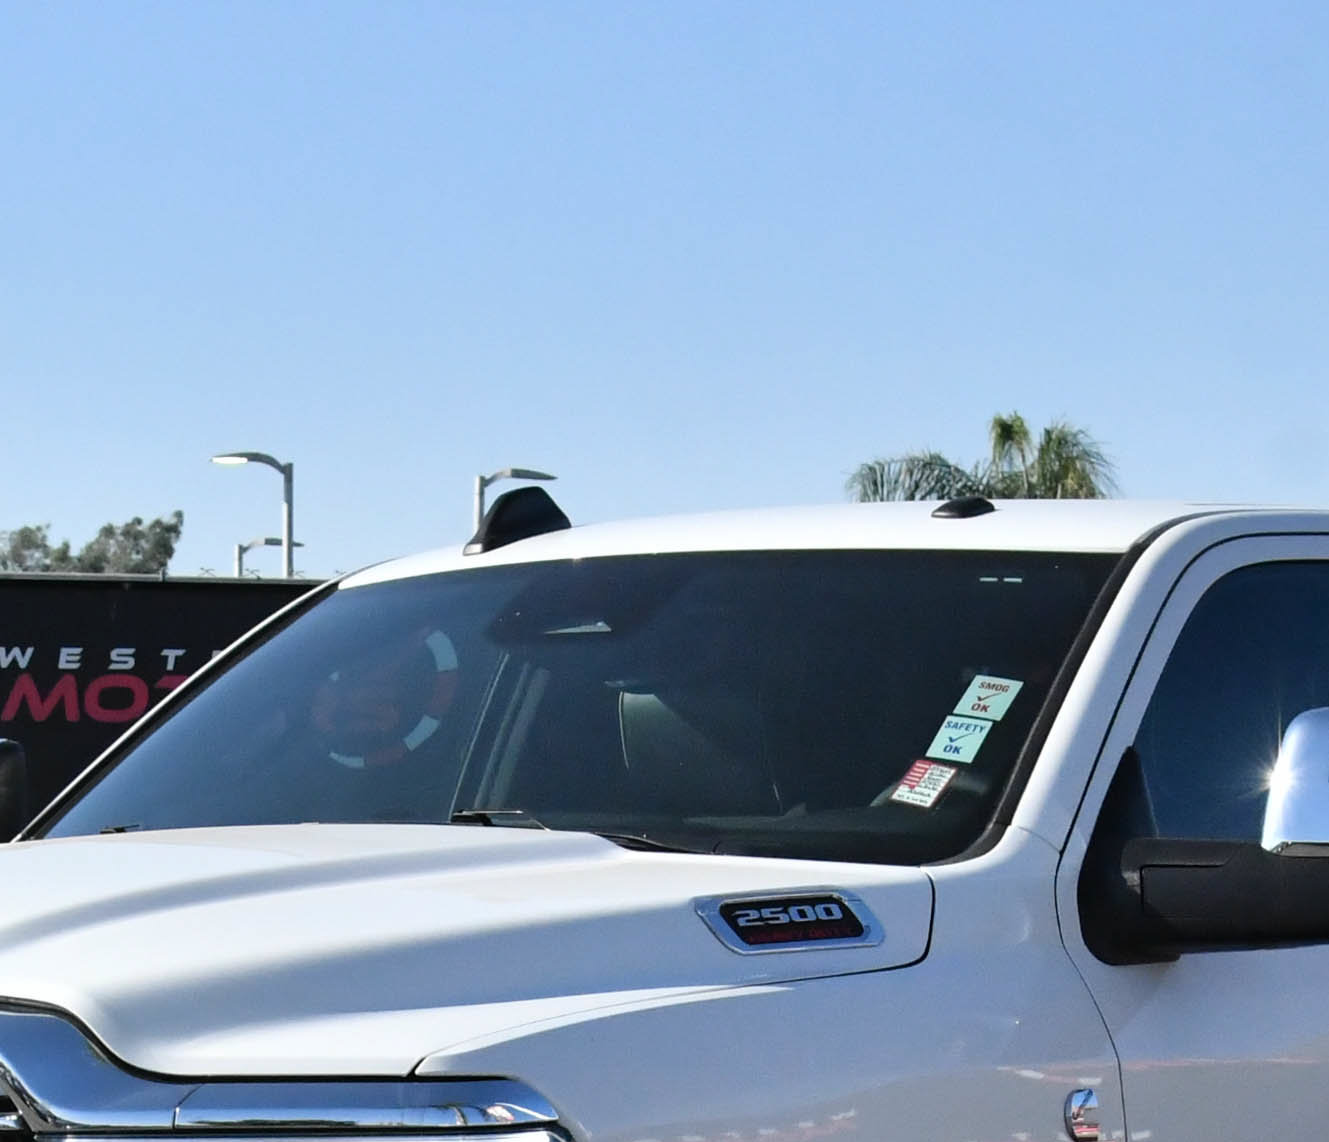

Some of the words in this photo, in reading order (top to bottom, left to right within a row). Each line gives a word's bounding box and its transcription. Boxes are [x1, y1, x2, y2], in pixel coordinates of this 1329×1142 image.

[978, 681, 1010, 693] SMOG
[971, 702, 990, 713] OK
[944, 720, 987, 733] SAFETY
[943, 744, 963, 755] OK
[733, 903, 843, 927] 2500
